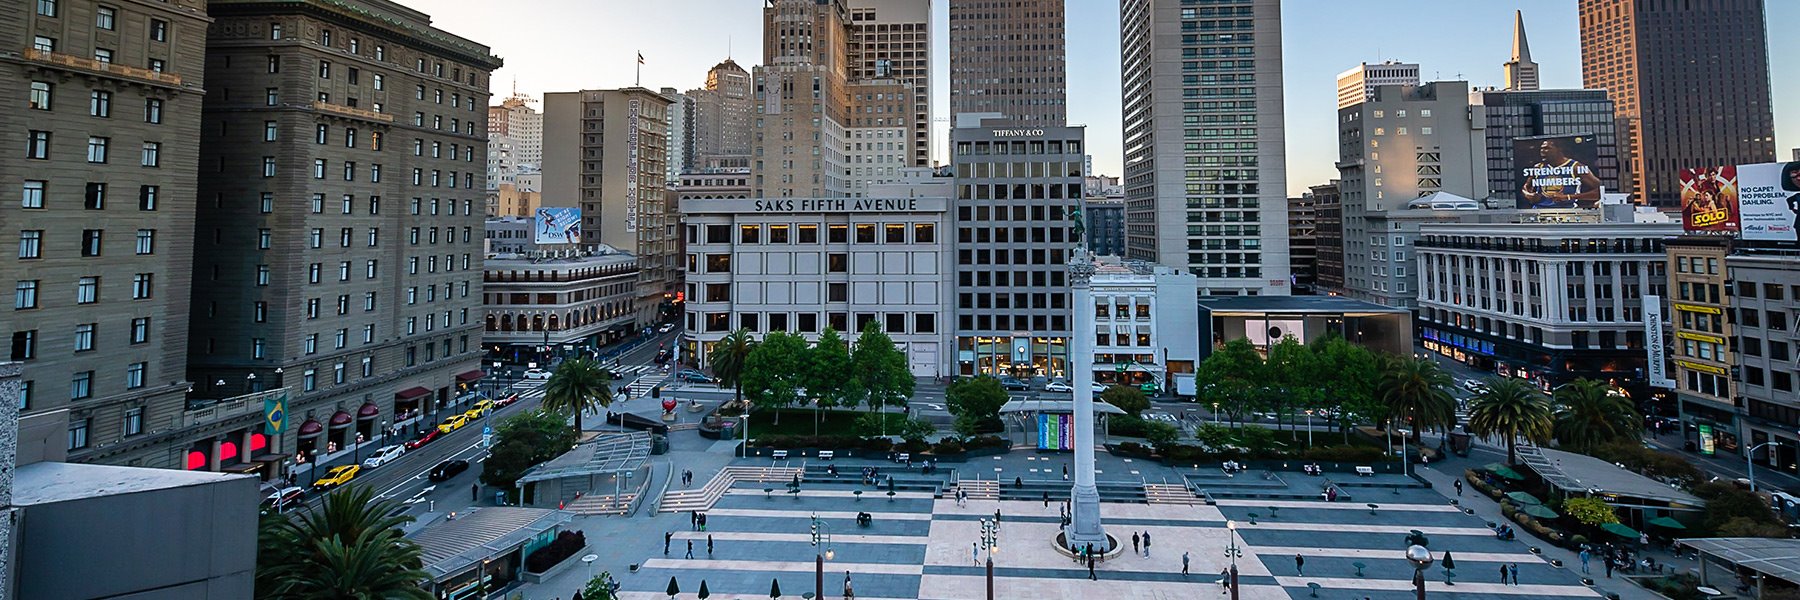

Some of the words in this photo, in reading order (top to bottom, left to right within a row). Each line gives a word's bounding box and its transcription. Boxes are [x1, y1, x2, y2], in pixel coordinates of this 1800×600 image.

[993, 129, 1025, 137] TIFFANY
[628, 100, 638, 183] CHANCELLOR
[1523, 166, 1573, 177] STRENGTH
[1577, 165, 1589, 174] IN
[1532, 177, 1582, 187] NUMBERS
[627, 187, 636, 230] HOTEL
[755, 199, 794, 211] SAKS
[802, 199, 845, 211] FIFTH
[854, 199, 917, 210] AVENUE
[1694, 211, 1725, 224] SOLO
[1648, 312, 1658, 344] JOHNSTON
[1652, 350, 1661, 376] MURPHY
